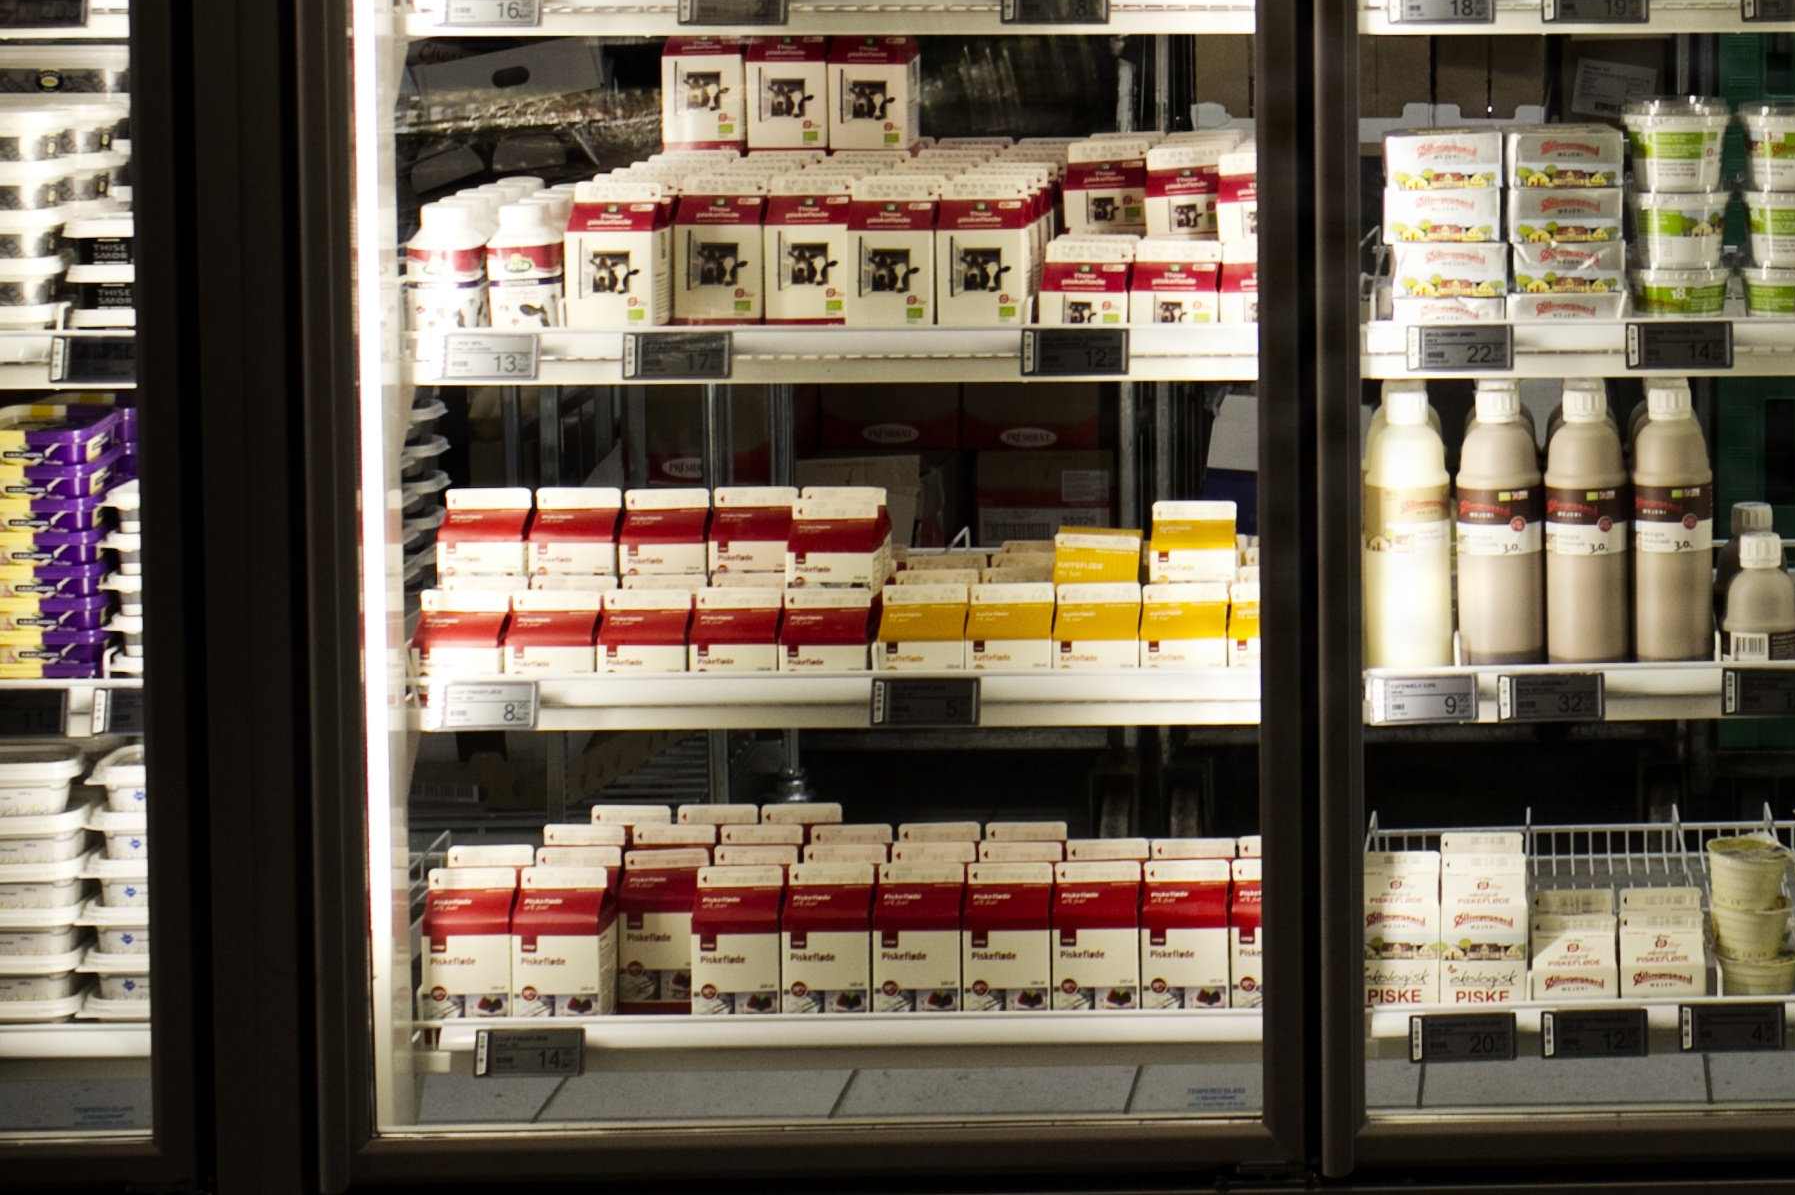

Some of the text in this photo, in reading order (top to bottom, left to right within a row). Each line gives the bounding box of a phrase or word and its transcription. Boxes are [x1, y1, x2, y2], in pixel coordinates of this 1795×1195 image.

[497, 1, 519, 18] 16
[1451, 0, 1474, 16] 18
[1467, 346, 1491, 364] 22
[492, 355, 517, 373] 13
[1444, 695, 1456, 715] 9
[503, 704, 515, 722] 8
[627, 933, 672, 942] Piskefløde
[700, 955, 746, 965] Piskefløde
[790, 953, 836, 963] Piskefløde
[881, 951, 927, 961] Piskefløde
[971, 951, 1017, 961] Piskefløde
[1060, 950, 1105, 960] Piskefløde
[1150, 950, 1195, 959] Piskefløde
[430, 957, 477, 968] Piskefløde
[521, 957, 566, 968] Piskefløde
[1548, 959, 1601, 967] PISKEFLØDE
[1450, 970, 1517, 989] økologisk
[1368, 989, 1422, 1003] PISKE
[1456, 991, 1510, 1003] PISKE
[1470, 1034, 1495, 1054] 20
[538, 1049, 560, 1069] 14
